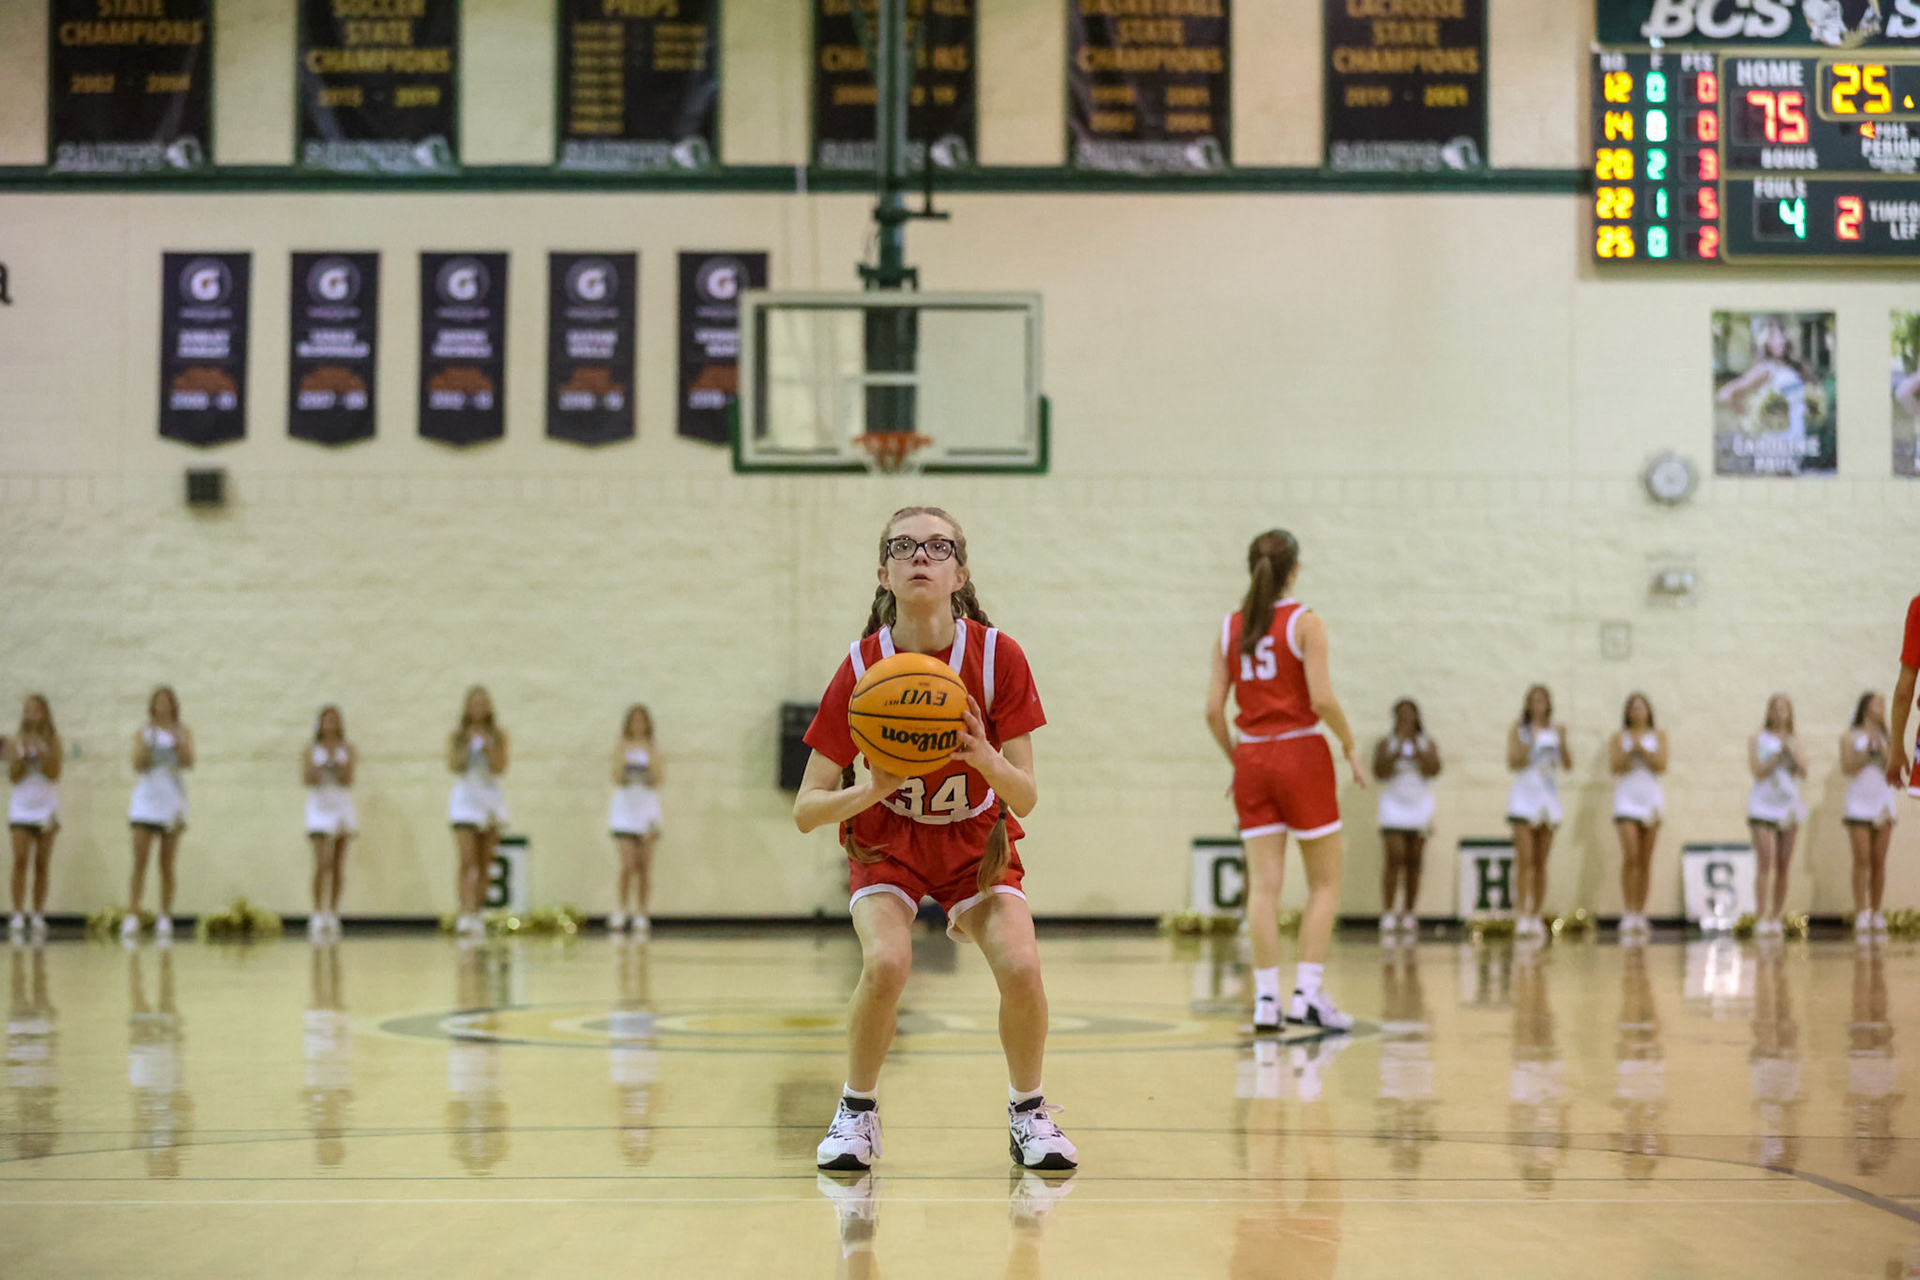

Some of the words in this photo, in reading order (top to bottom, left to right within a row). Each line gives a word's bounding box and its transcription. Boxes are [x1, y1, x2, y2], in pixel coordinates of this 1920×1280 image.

[59, 20, 203, 45] CHAMPIONS
[346, 20, 413, 45] STATE
[1118, 19, 1183, 44] STATE
[1373, 20, 1439, 46] STATE
[1640, 0, 1793, 38] BCS
[307, 48, 450, 73] CHAMPIONS
[1077, 47, 1224, 73] CHAMPIONS
[1332, 48, 1480, 74] CHAMPIONS
[1737, 61, 1804, 86] HOME
[1604, 71, 1633, 103] 12
[1646, 71, 1667, 103] 0
[1697, 71, 1718, 103] 0
[1604, 110, 1634, 141] 14
[1697, 109, 1718, 142] 0
[1746, 91, 1808, 143] 75
[1596, 148, 1634, 180] 20
[1647, 148, 1668, 180] 2
[1698, 148, 1719, 180] 3
[1761, 148, 1818, 169] BONUS
[1596, 187, 1635, 219] 22
[1656, 187, 1668, 219] 1
[1698, 186, 1719, 219] 5
[1754, 176, 1807, 198] FOULS
[1779, 197, 1806, 239] 4
[1836, 195, 1863, 240] 2
[1890, 221, 1920, 240] LEF
[1596, 225, 1636, 258] 25
[1647, 225, 1668, 258] 0
[1698, 225, 1719, 258] 2
[191, 267, 220, 300] G
[319, 267, 348, 300] G
[448, 268, 477, 300] G
[577, 268, 606, 300] G
[708, 268, 738, 300] G
[1241, 635, 1278, 681] 15
[881, 725, 958, 752] Wilson
[895, 773, 972, 816] 34
[1213, 857, 1246, 909] C
[1476, 858, 1512, 910] H
[1704, 861, 1738, 917] S
